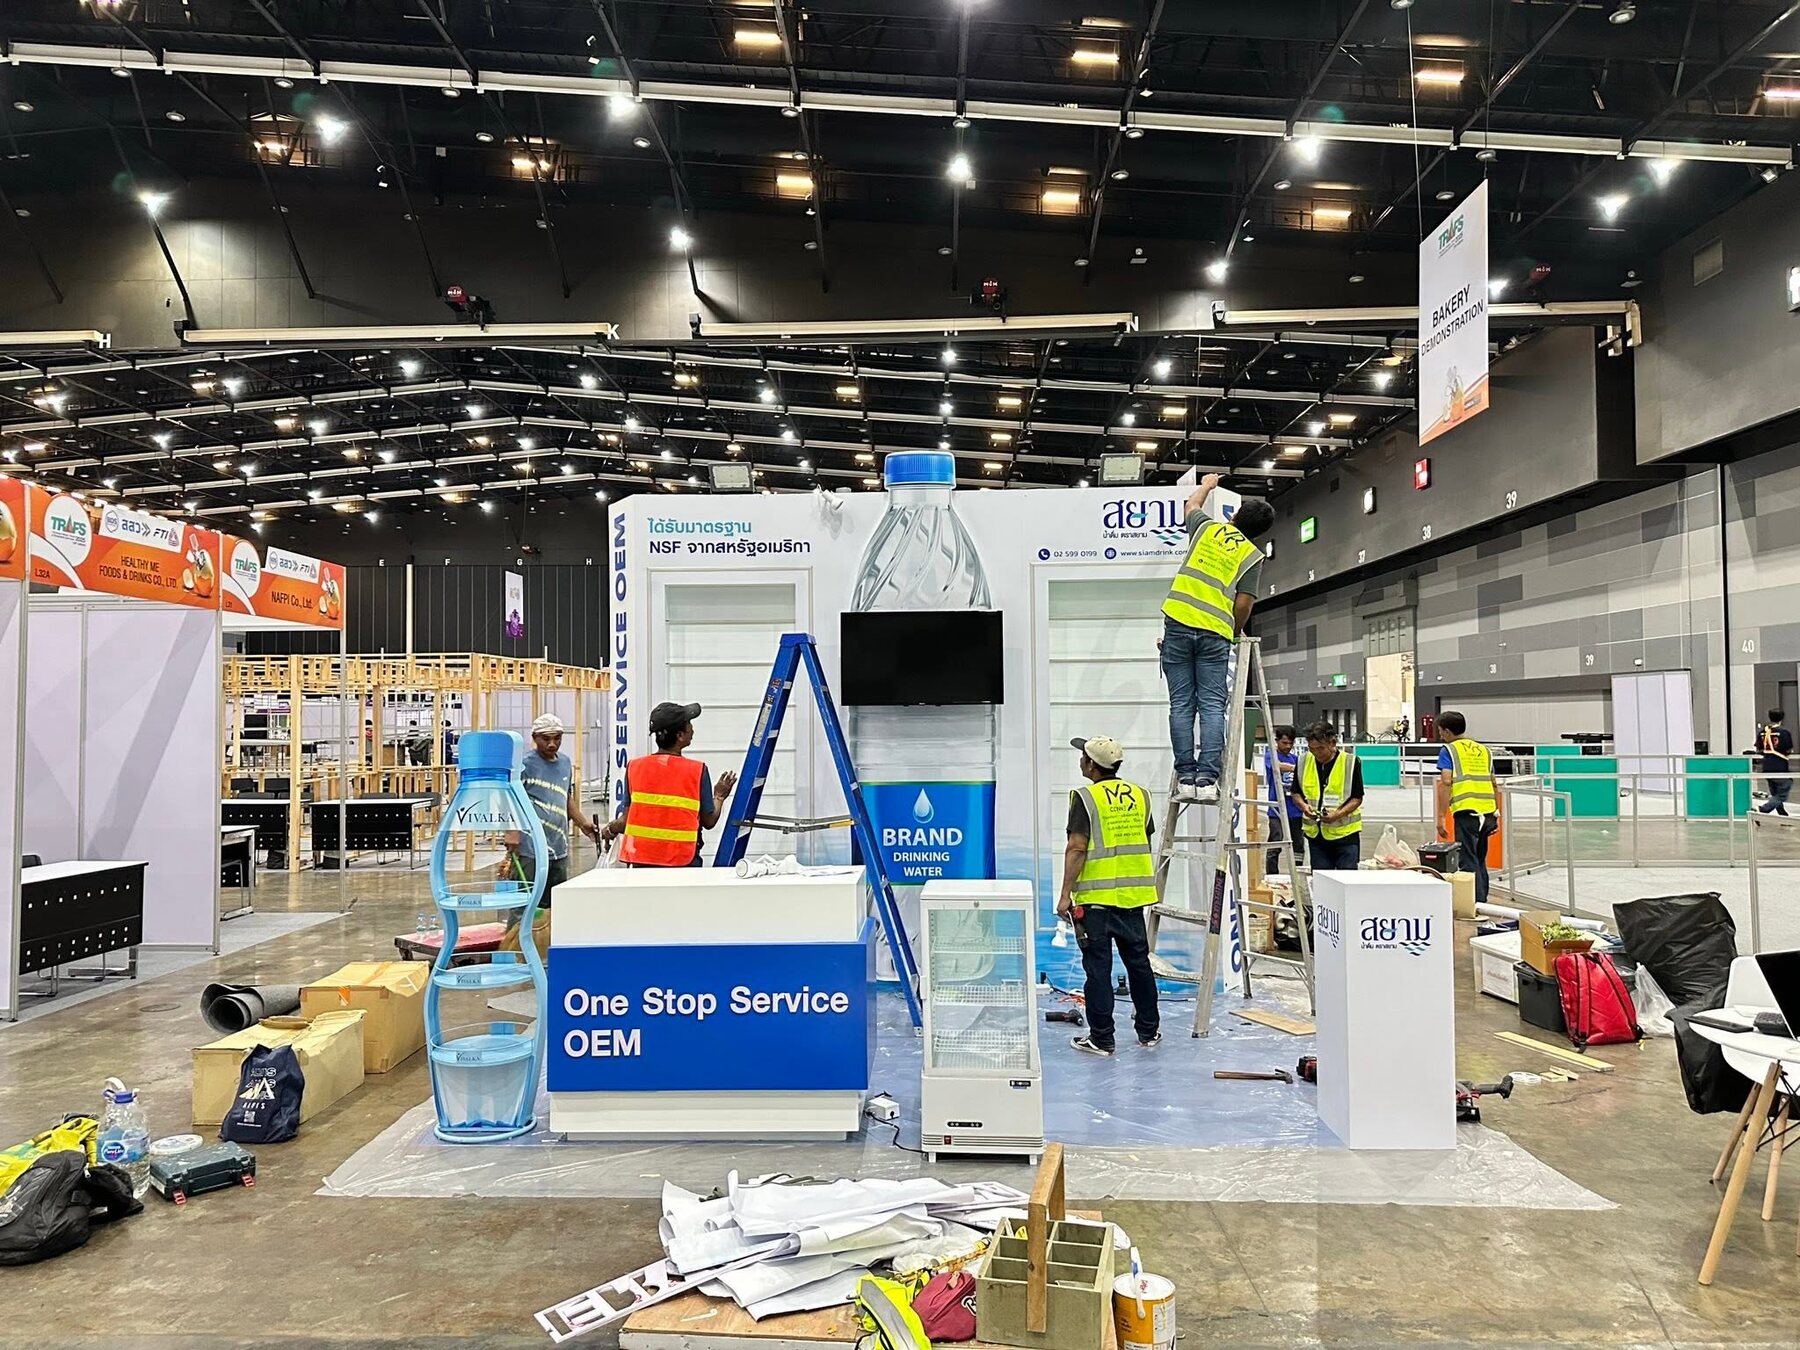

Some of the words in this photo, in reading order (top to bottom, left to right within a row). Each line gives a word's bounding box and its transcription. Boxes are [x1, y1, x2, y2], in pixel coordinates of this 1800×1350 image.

[1432, 283, 1471, 329] BAKERY
[607, 323, 620, 340] K
[1421, 299, 1484, 357] DEMONSTRATION
[99, 333, 111, 349] H
[1505, 490, 1518, 509] 39
[1103, 499, 1187, 529] สยาม
[50, 513, 87, 537] TRAFS
[153, 527, 169, 540] FTI
[647, 517, 752, 537] ได้รับมาตรฐาน
[1422, 524, 1432, 541] 38
[649, 540, 682, 554] NSF
[687, 538, 811, 557] จากสหรัฐอเมริกา
[1053, 550, 1063, 558] 02
[1065, 550, 1079, 558] 599
[1080, 550, 1098, 558] 0199
[120, 555, 150, 571] HEALTHY
[150, 561, 160, 572] ME
[378, 559, 385, 567] E
[445, 558, 450, 566] F
[516, 558, 523, 566] G
[586, 558, 592, 566] H
[614, 512, 627, 602] OEM
[34, 567, 51, 579] L32A
[99, 564, 122, 579] FOODS
[122, 569, 129, 581] &
[129, 570, 153, 585] DRINKS
[271, 590, 290, 606] NAFPI
[1742, 640, 1754, 653] 40
[1585, 654, 1594, 666] 39
[615, 611, 628, 768] SERVICE
[456, 801, 515, 825] VIVALKA
[882, 827, 963, 847] BRAND
[893, 851, 950, 862] DRINKING
[903, 866, 943, 877] WATER
[1360, 916, 1432, 941] สยาม
[563, 987, 629, 1017] One
[641, 986, 718, 1021] Stop
[729, 985, 850, 1015] Service
[563, 1028, 642, 1058] OEM
